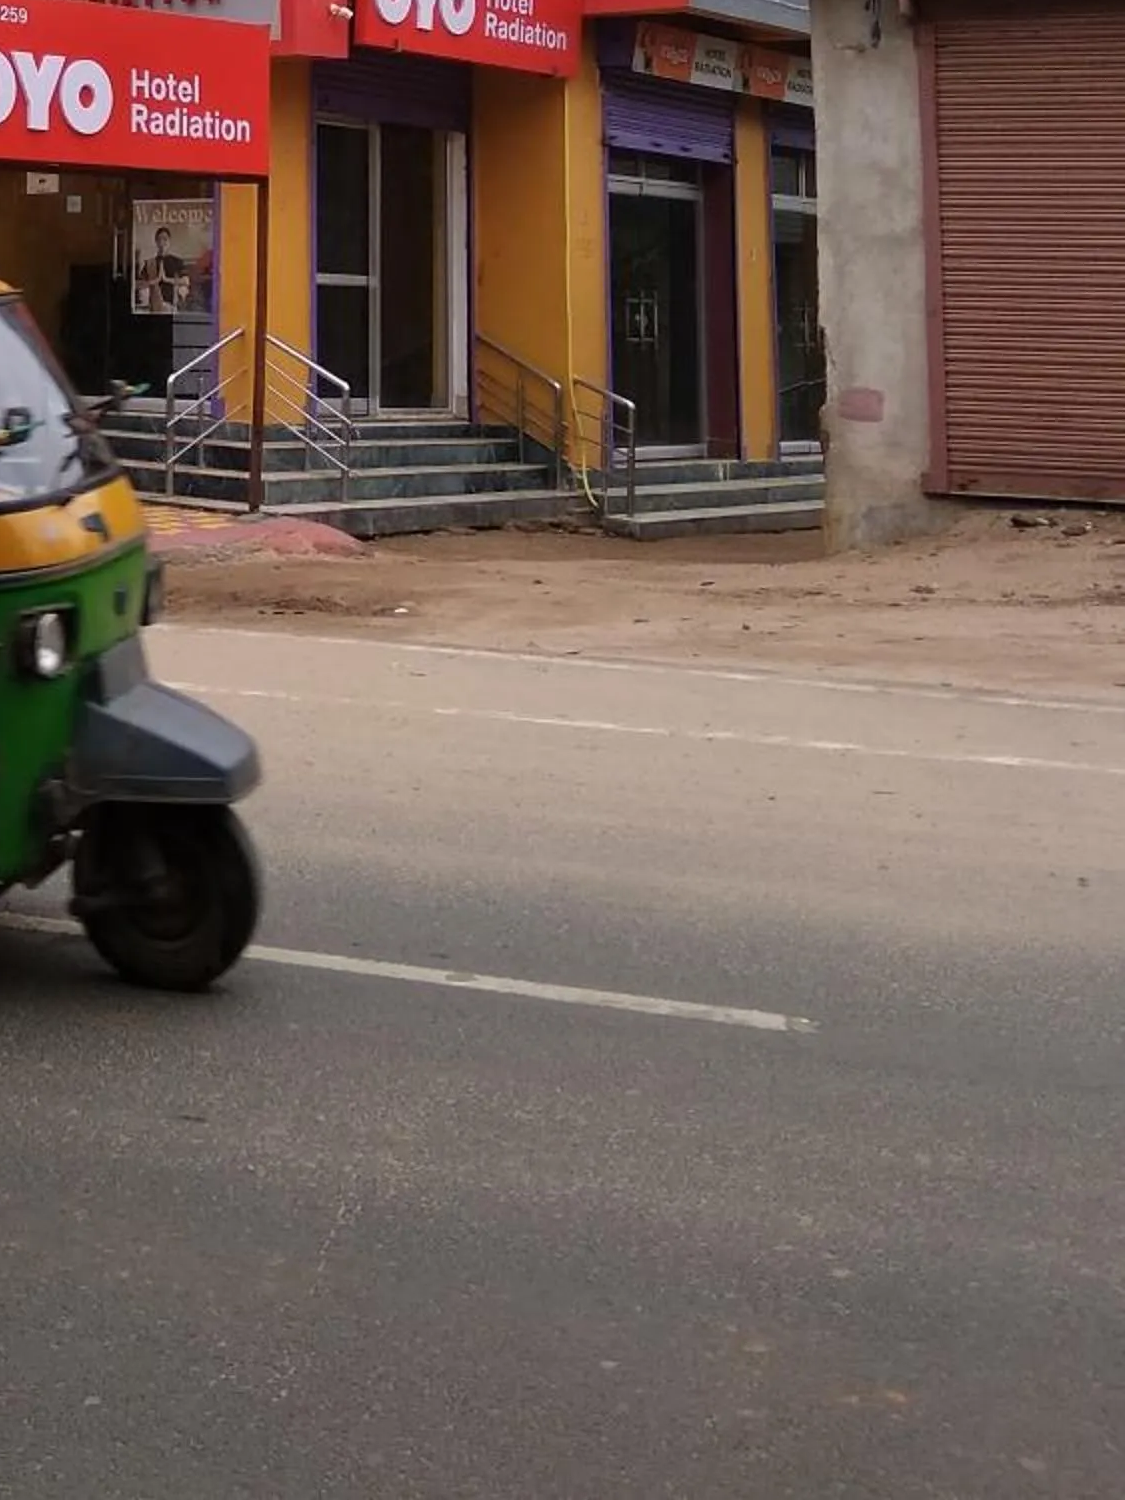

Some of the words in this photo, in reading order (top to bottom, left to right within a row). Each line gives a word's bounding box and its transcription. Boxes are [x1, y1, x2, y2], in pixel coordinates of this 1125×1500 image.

[484, 11, 567, 50] Radiation
[131, 68, 200, 104] Hotel
[130, 104, 250, 142] Radiation
[136, 205, 213, 223] Welcome
